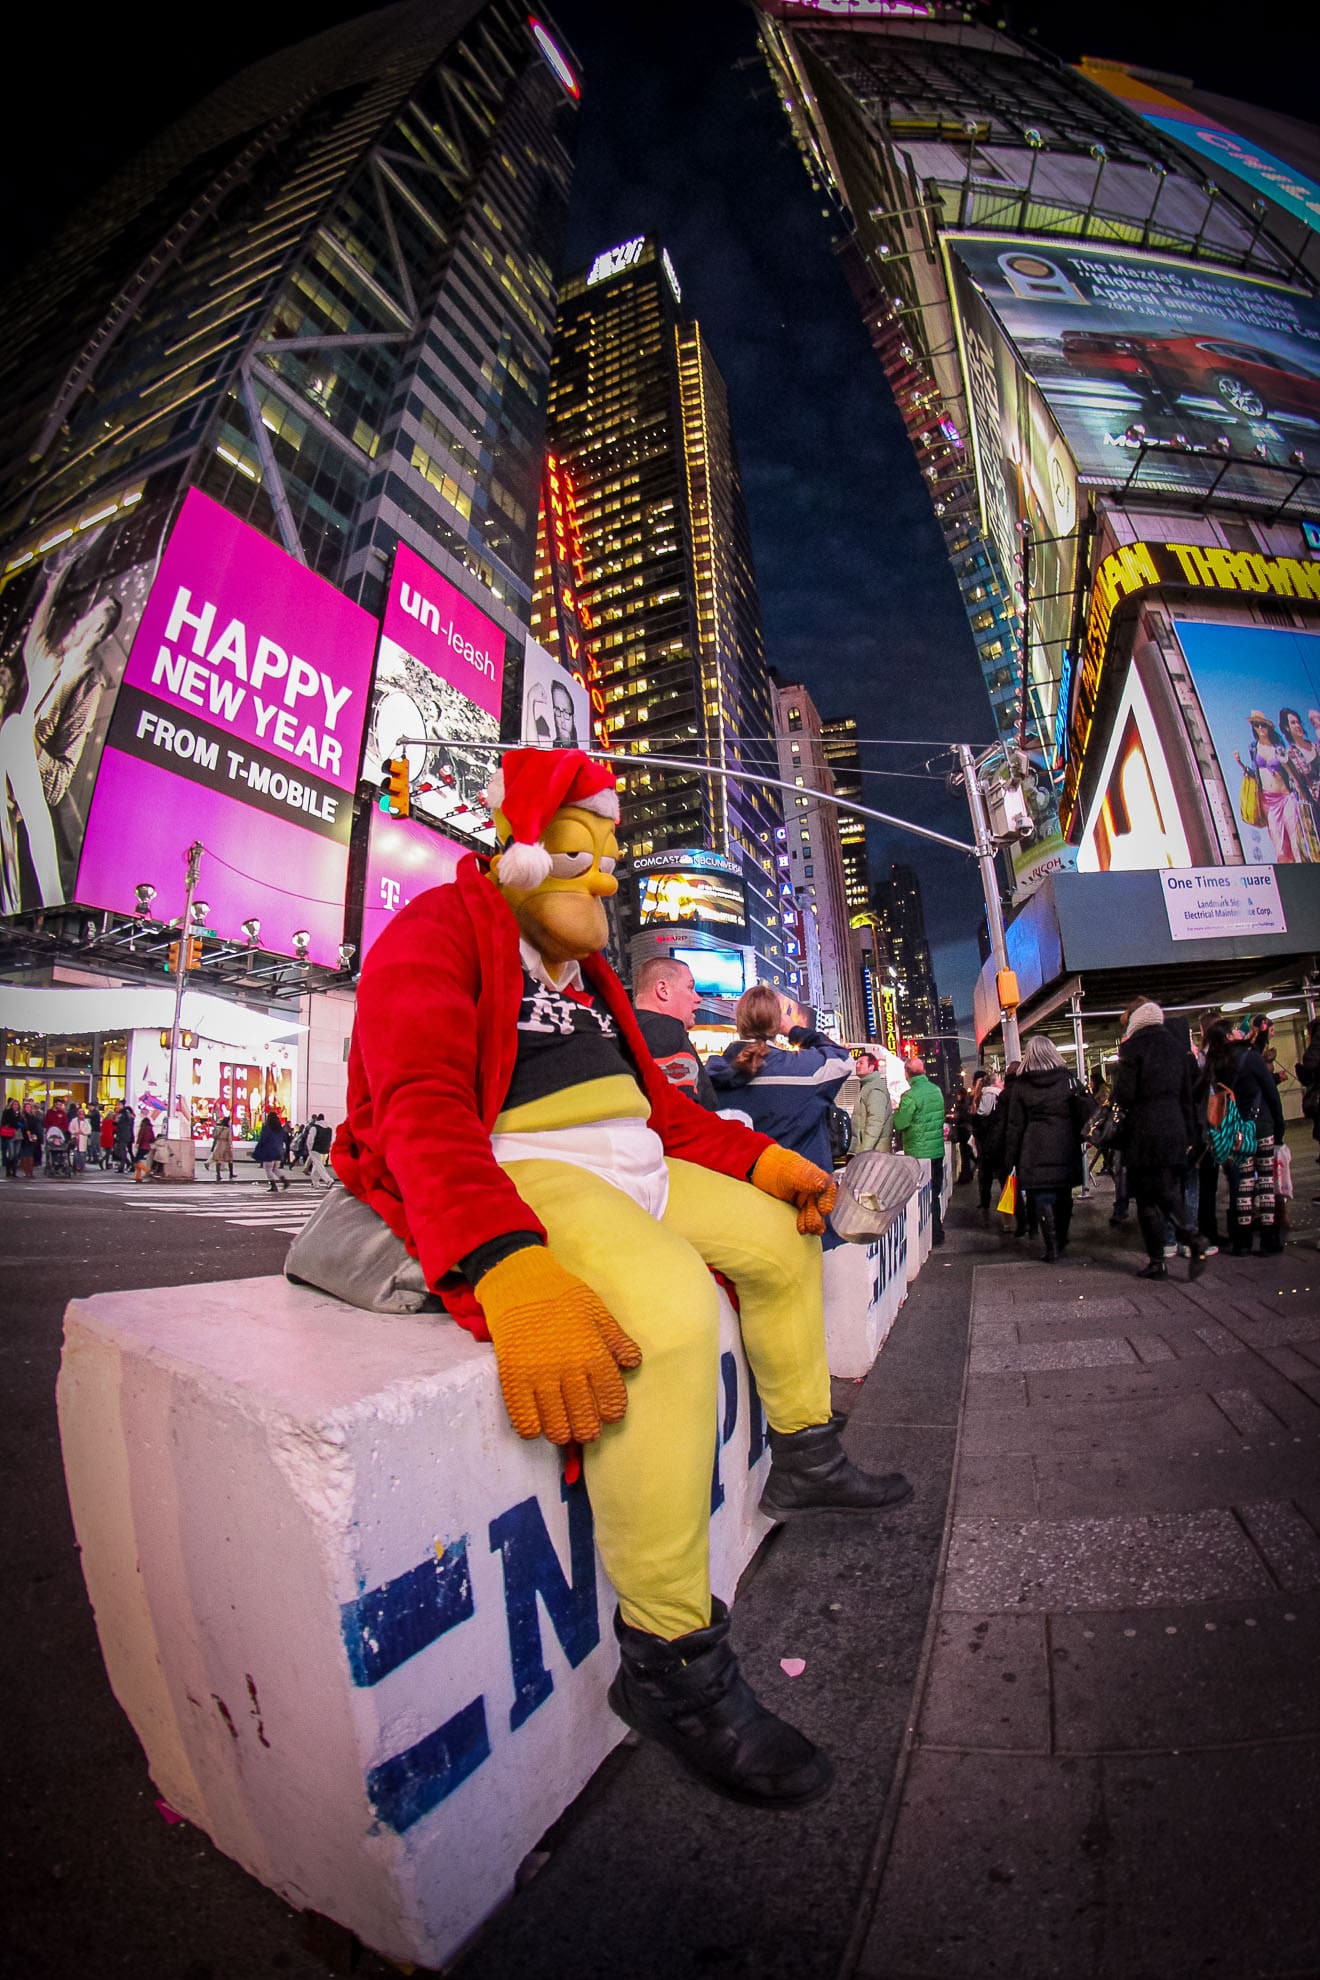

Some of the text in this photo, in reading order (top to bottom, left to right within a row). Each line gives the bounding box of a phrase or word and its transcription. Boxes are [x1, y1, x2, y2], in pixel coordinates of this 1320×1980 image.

[1067, 258, 1107, 274] The
[1091, 285, 1160, 306] Appeal
[1164, 297, 1228, 320] among
[1169, 286, 1236, 308] Ranked
[962, 316, 993, 485] OWNERS
[547, 455, 567, 562] ERNST
[562, 588, 575, 612] &
[400, 581, 495, 681] un-leash
[163, 586, 353, 731] HAPPY
[151, 647, 344, 777] NEW YEAR
[136, 709, 339, 825] FROM T-MOBILE
[634, 855, 680, 869] COMCAST
[1032, 857, 1062, 878] RICOH
[1168, 875, 1271, 889] One Times quare
[776, 828, 798, 984] CHAMPS
[1184, 907, 1273, 920] Electrical Maintece Corp.
[1197, 899, 1229, 909] Landmark
